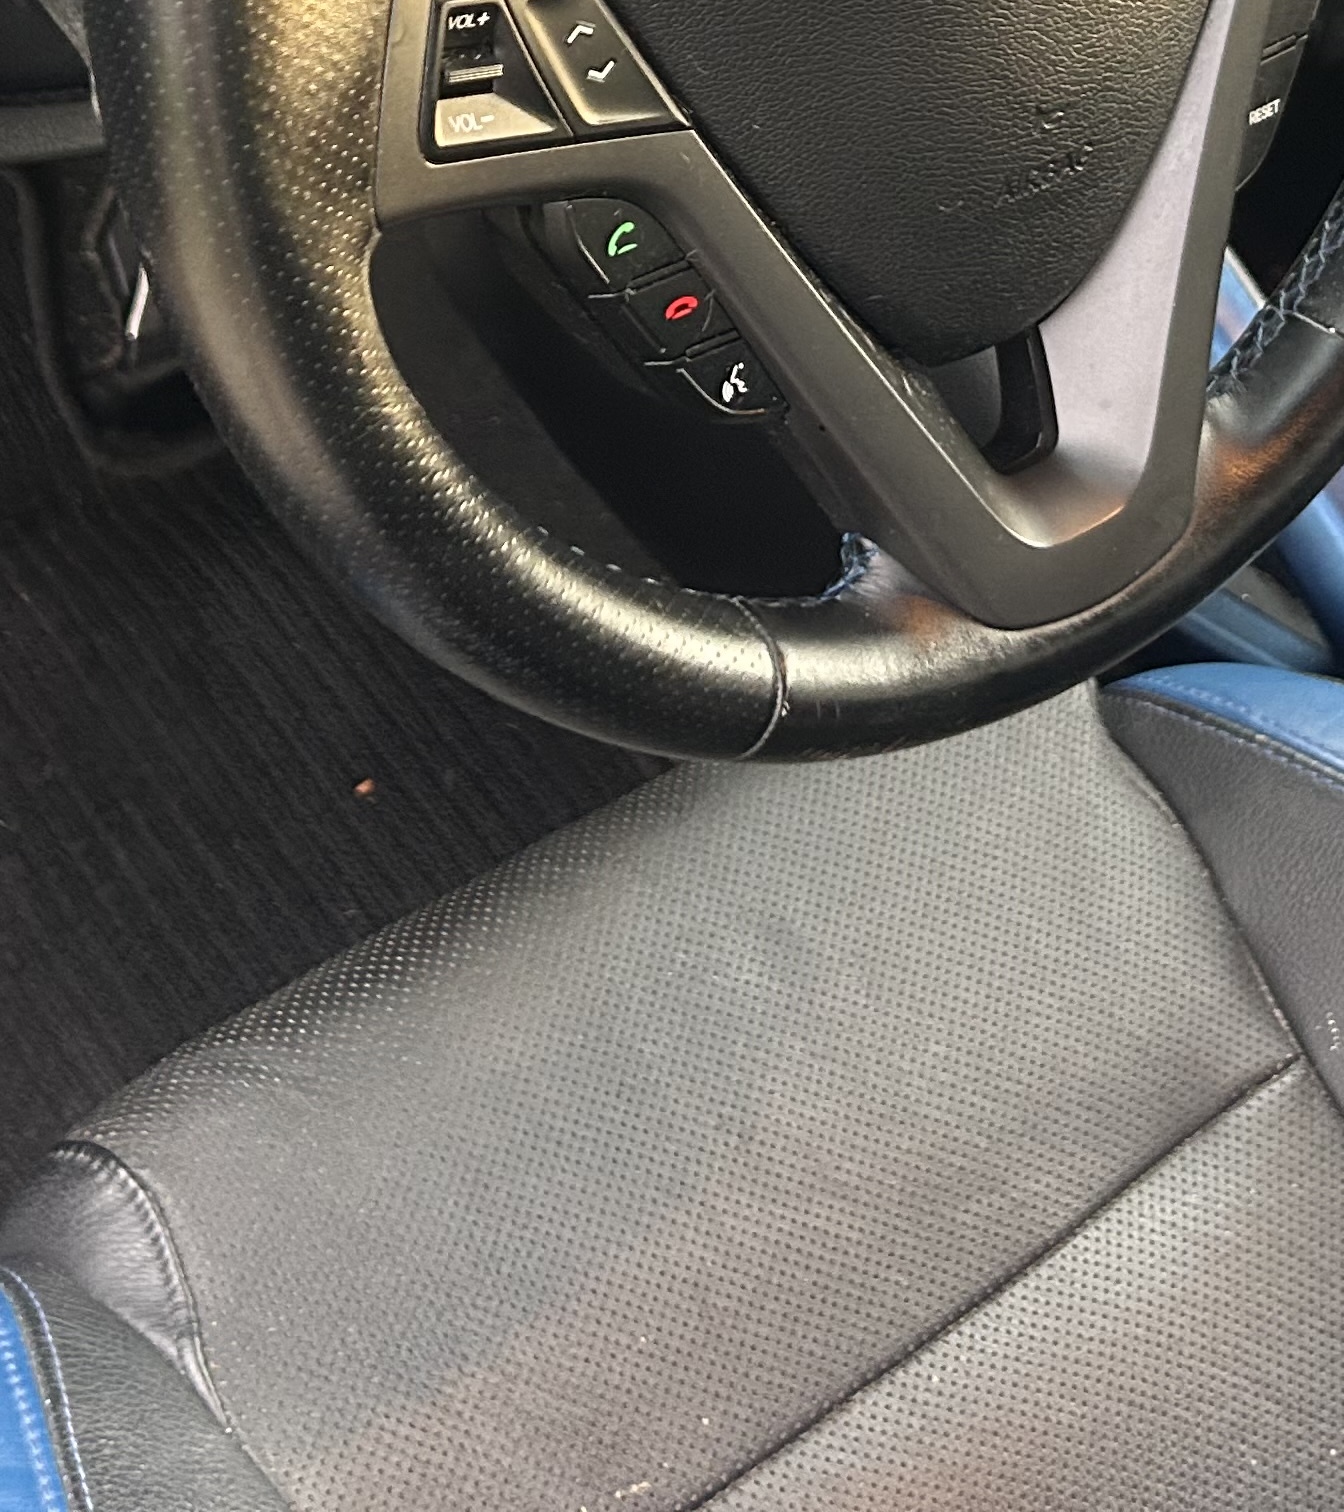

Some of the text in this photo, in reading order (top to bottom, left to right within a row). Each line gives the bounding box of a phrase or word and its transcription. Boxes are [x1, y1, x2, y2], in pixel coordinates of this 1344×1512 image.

[448, 11, 490, 31] VOL+
[448, 112, 495, 133] VOL-
[1248, 98, 1281, 126] RESET
